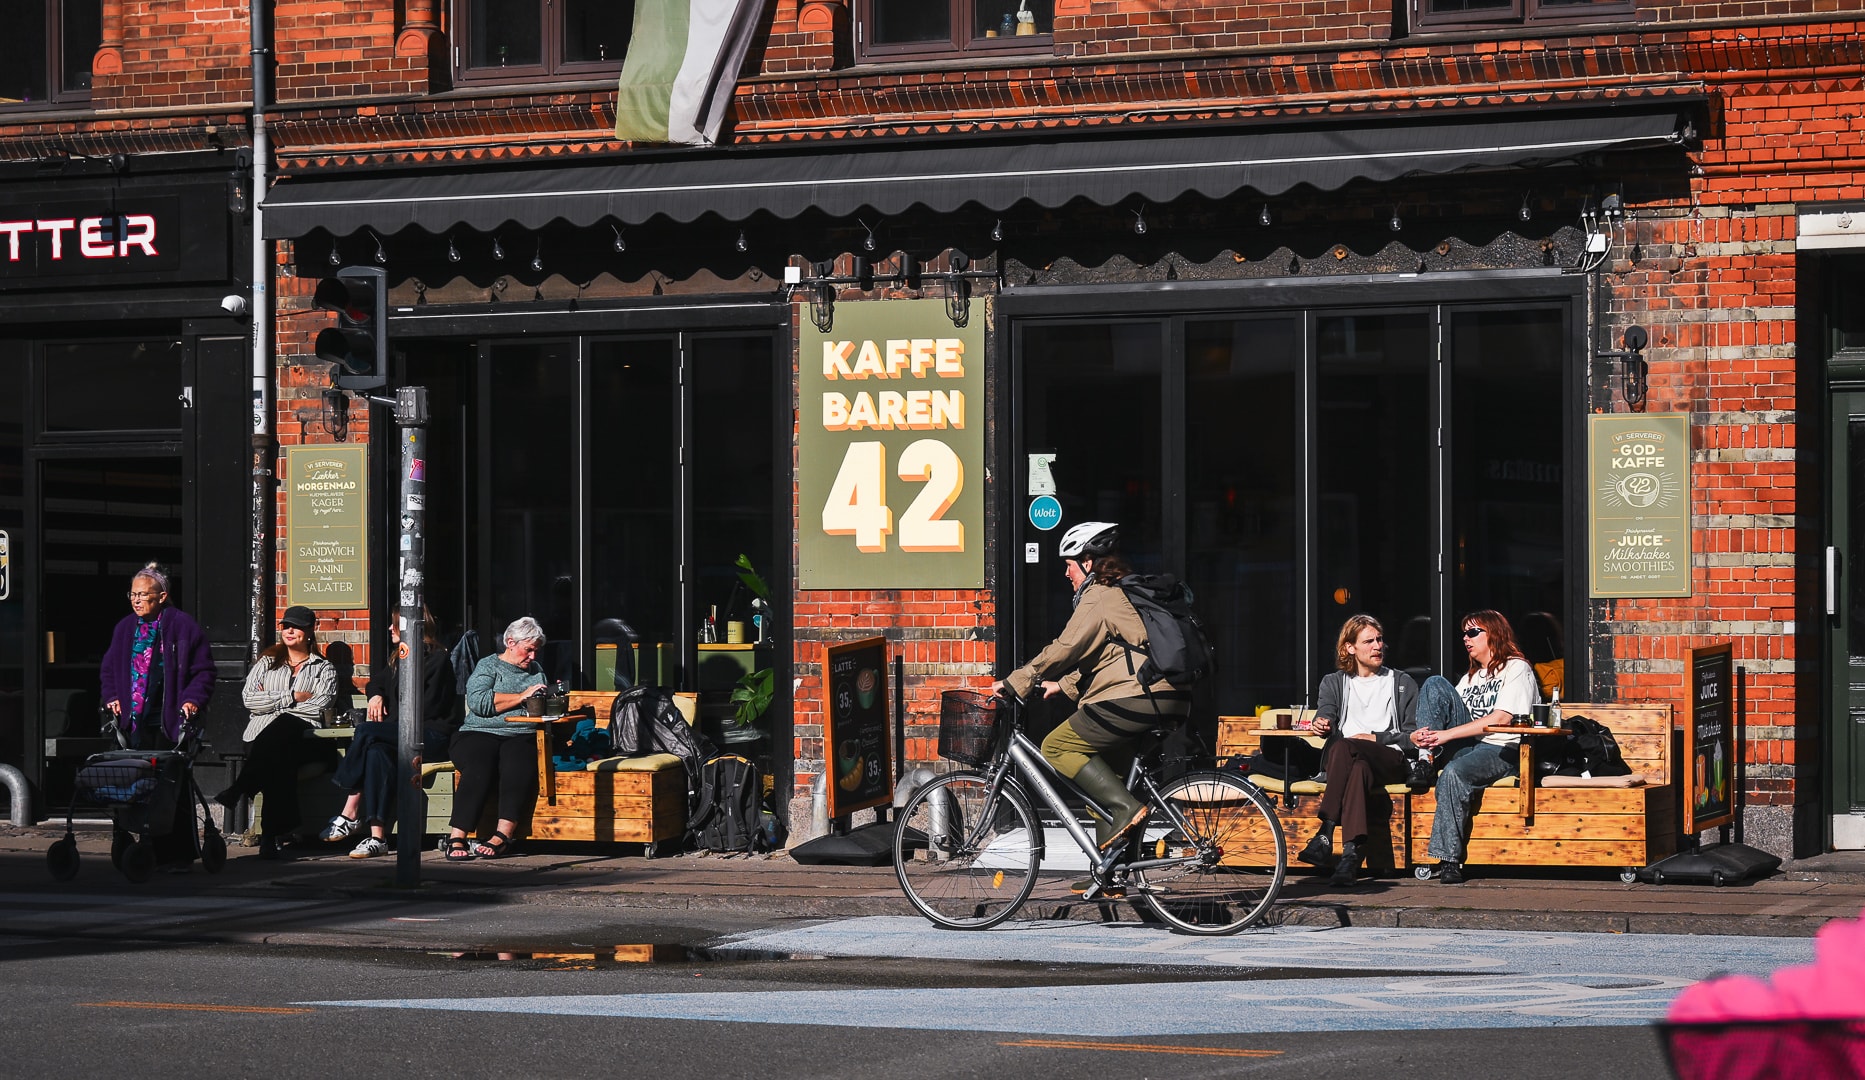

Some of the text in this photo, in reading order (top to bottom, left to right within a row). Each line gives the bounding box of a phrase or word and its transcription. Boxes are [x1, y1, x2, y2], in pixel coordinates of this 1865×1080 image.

[823, 338, 965, 380] KAFFE
[823, 390, 965, 432] BAREN
[1626, 432, 1662, 440] SERVERER
[1620, 444, 1656, 456] GOD
[1612, 457, 1665, 469] KAFFE
[297, 481, 356, 491] MORGENMAD
[1629, 477, 1651, 494] 42
[822, 438, 965, 553] 42
[311, 498, 344, 507] KAGER
[1034, 507, 1057, 518] Wolt
[1617, 535, 1663, 547] JUICE
[299, 546, 355, 556] SANDWICH
[1604, 547, 1671, 561] Milkshakes
[310, 564, 344, 574] PANINI
[1603, 561, 1675, 572] SMOOTHIES
[303, 582, 353, 593] SALATER
[834, 661, 852, 673] LATTE
[1700, 683, 1718, 700] JUICE
[1465, 693, 1499, 709] AGAIN
